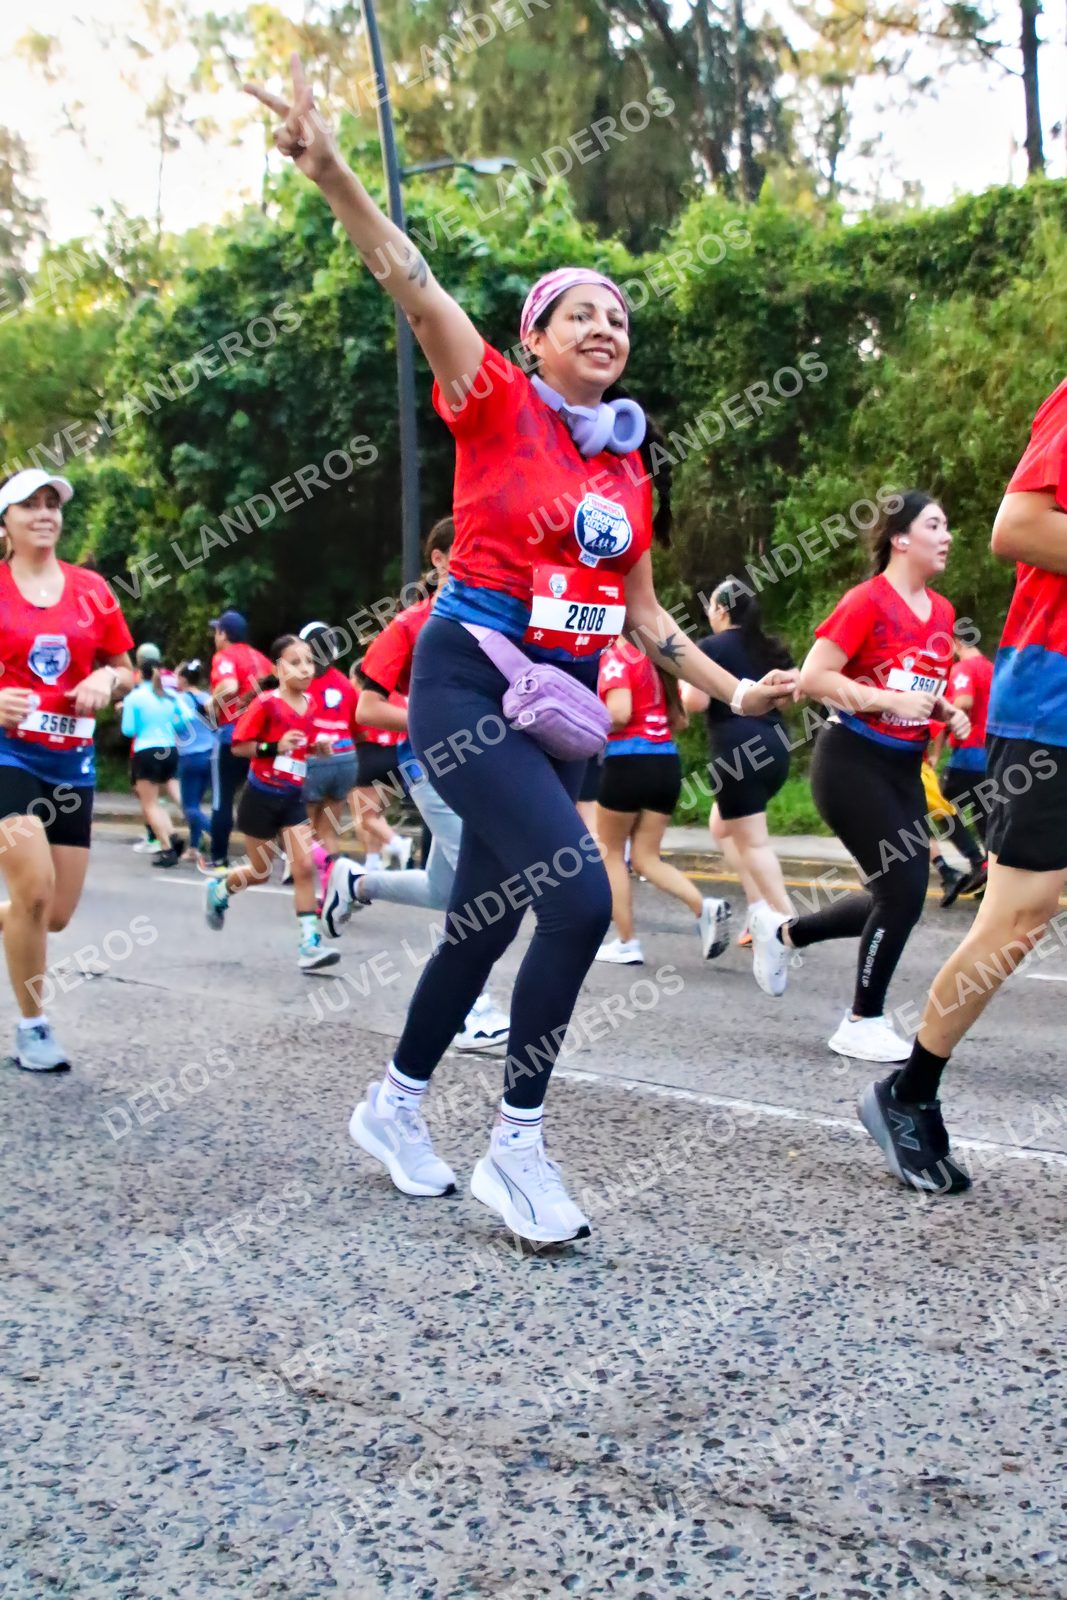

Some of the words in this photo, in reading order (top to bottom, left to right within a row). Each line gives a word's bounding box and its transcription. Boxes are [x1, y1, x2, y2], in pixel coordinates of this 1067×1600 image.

[584, 515, 608, 533] Race
[565, 604, 606, 632] 2808
[40, 714, 77, 735] 2566
[868, 928, 886, 957] NEVER
[863, 955, 875, 976] GIVE
[861, 975, 870, 988] UP
